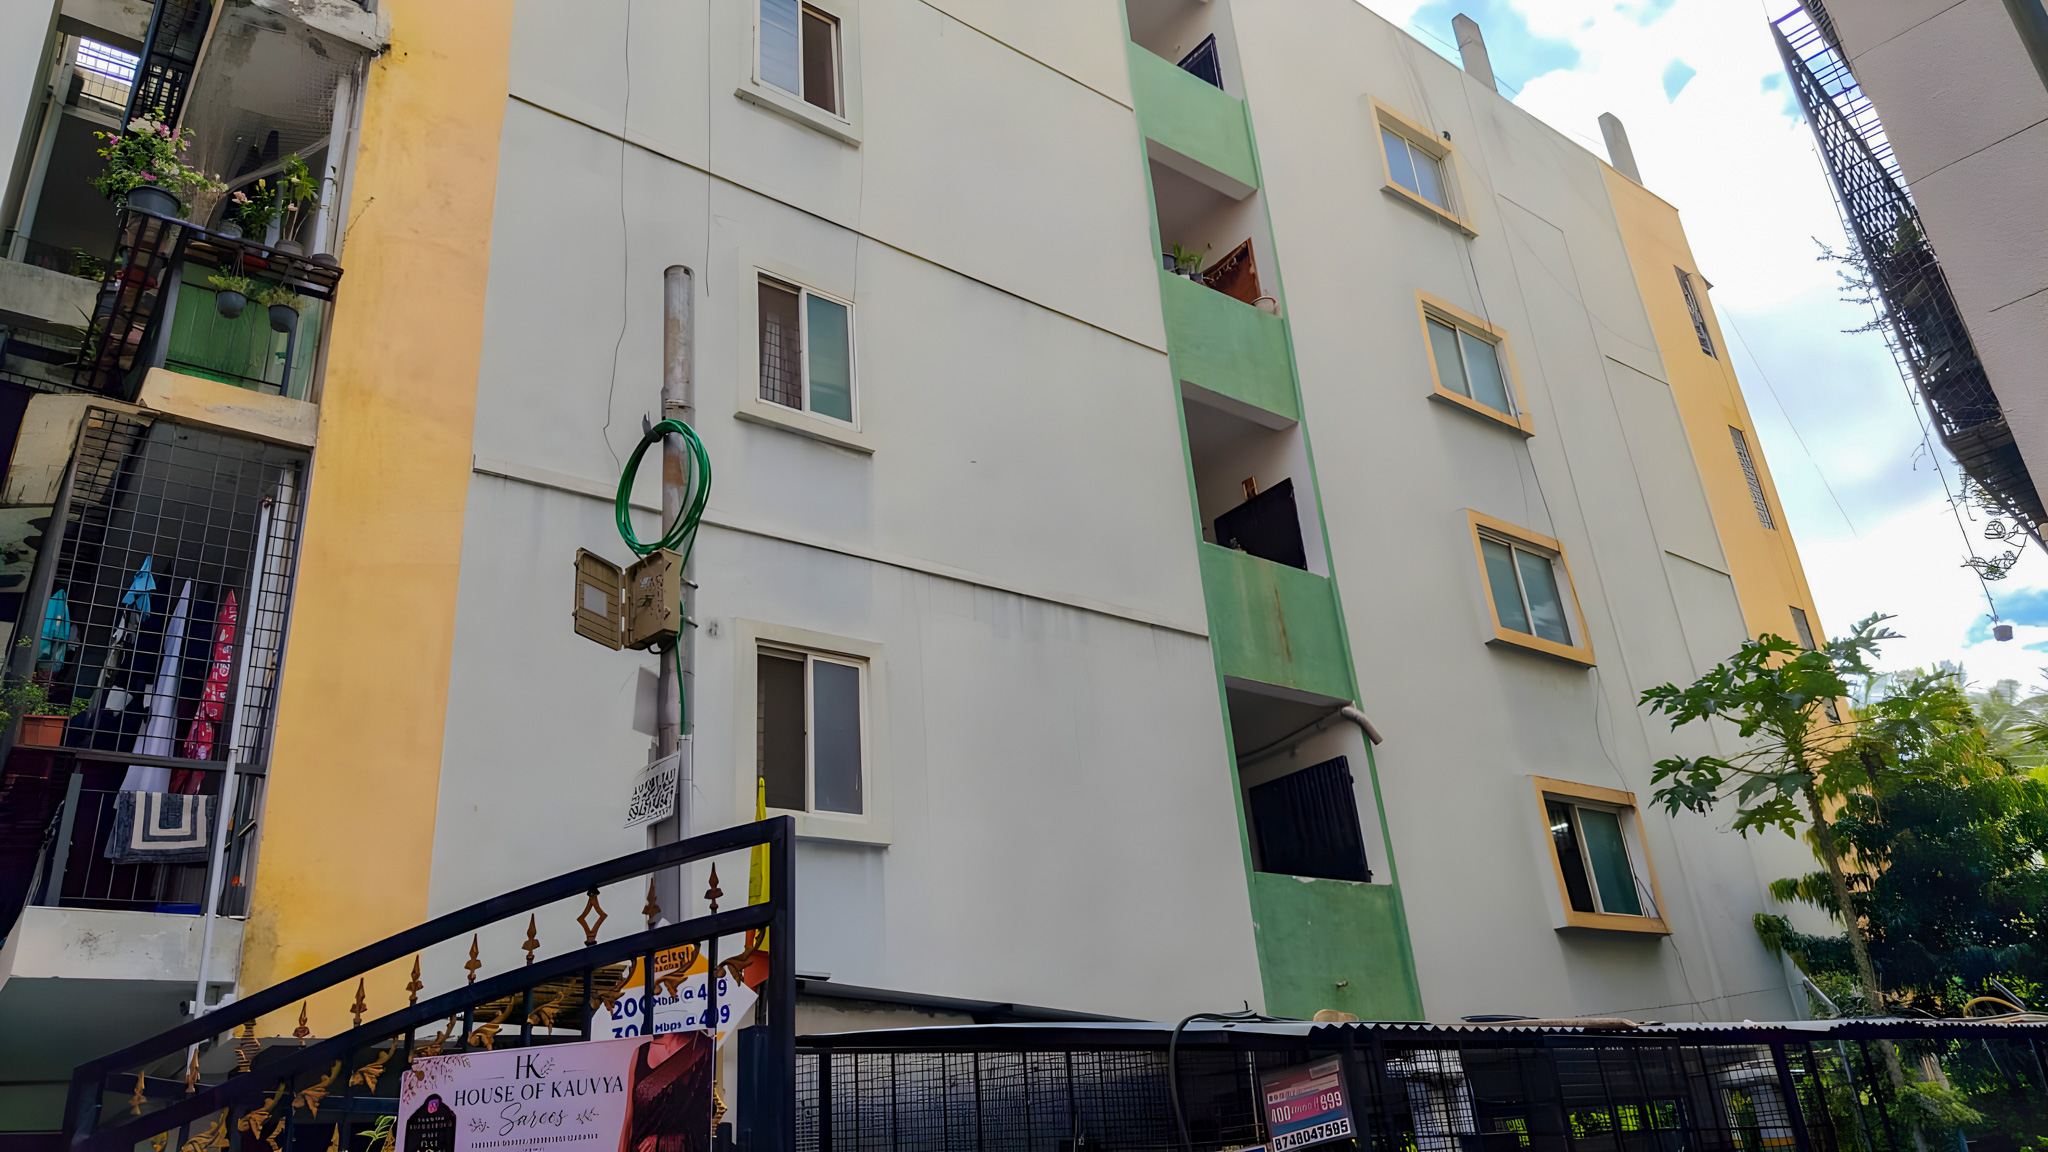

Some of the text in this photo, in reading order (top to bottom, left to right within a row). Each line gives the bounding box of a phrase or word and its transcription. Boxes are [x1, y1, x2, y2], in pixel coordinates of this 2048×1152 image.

[655, 1022, 682, 1033] Mbps
[515, 1053, 545, 1080] HK
[454, 1075, 624, 1107] HOUSE OF KAUVYA
